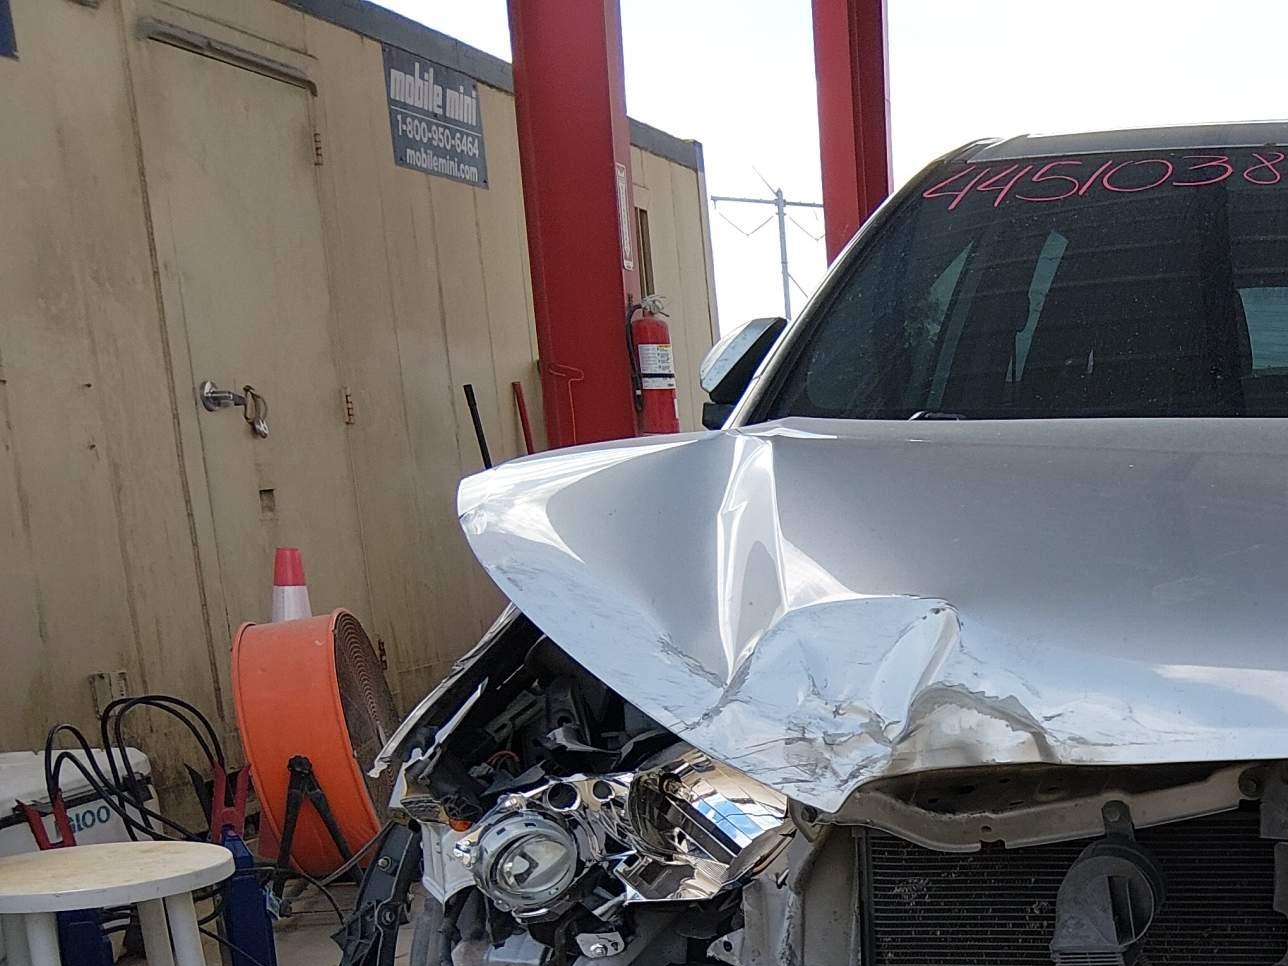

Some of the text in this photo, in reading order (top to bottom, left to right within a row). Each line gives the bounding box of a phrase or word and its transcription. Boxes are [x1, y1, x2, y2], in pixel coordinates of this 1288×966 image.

[390, 62, 477, 126] mobile mini
[397, 114, 479, 158] 1-800-950-6464
[406, 148, 478, 182] mobilemini.com
